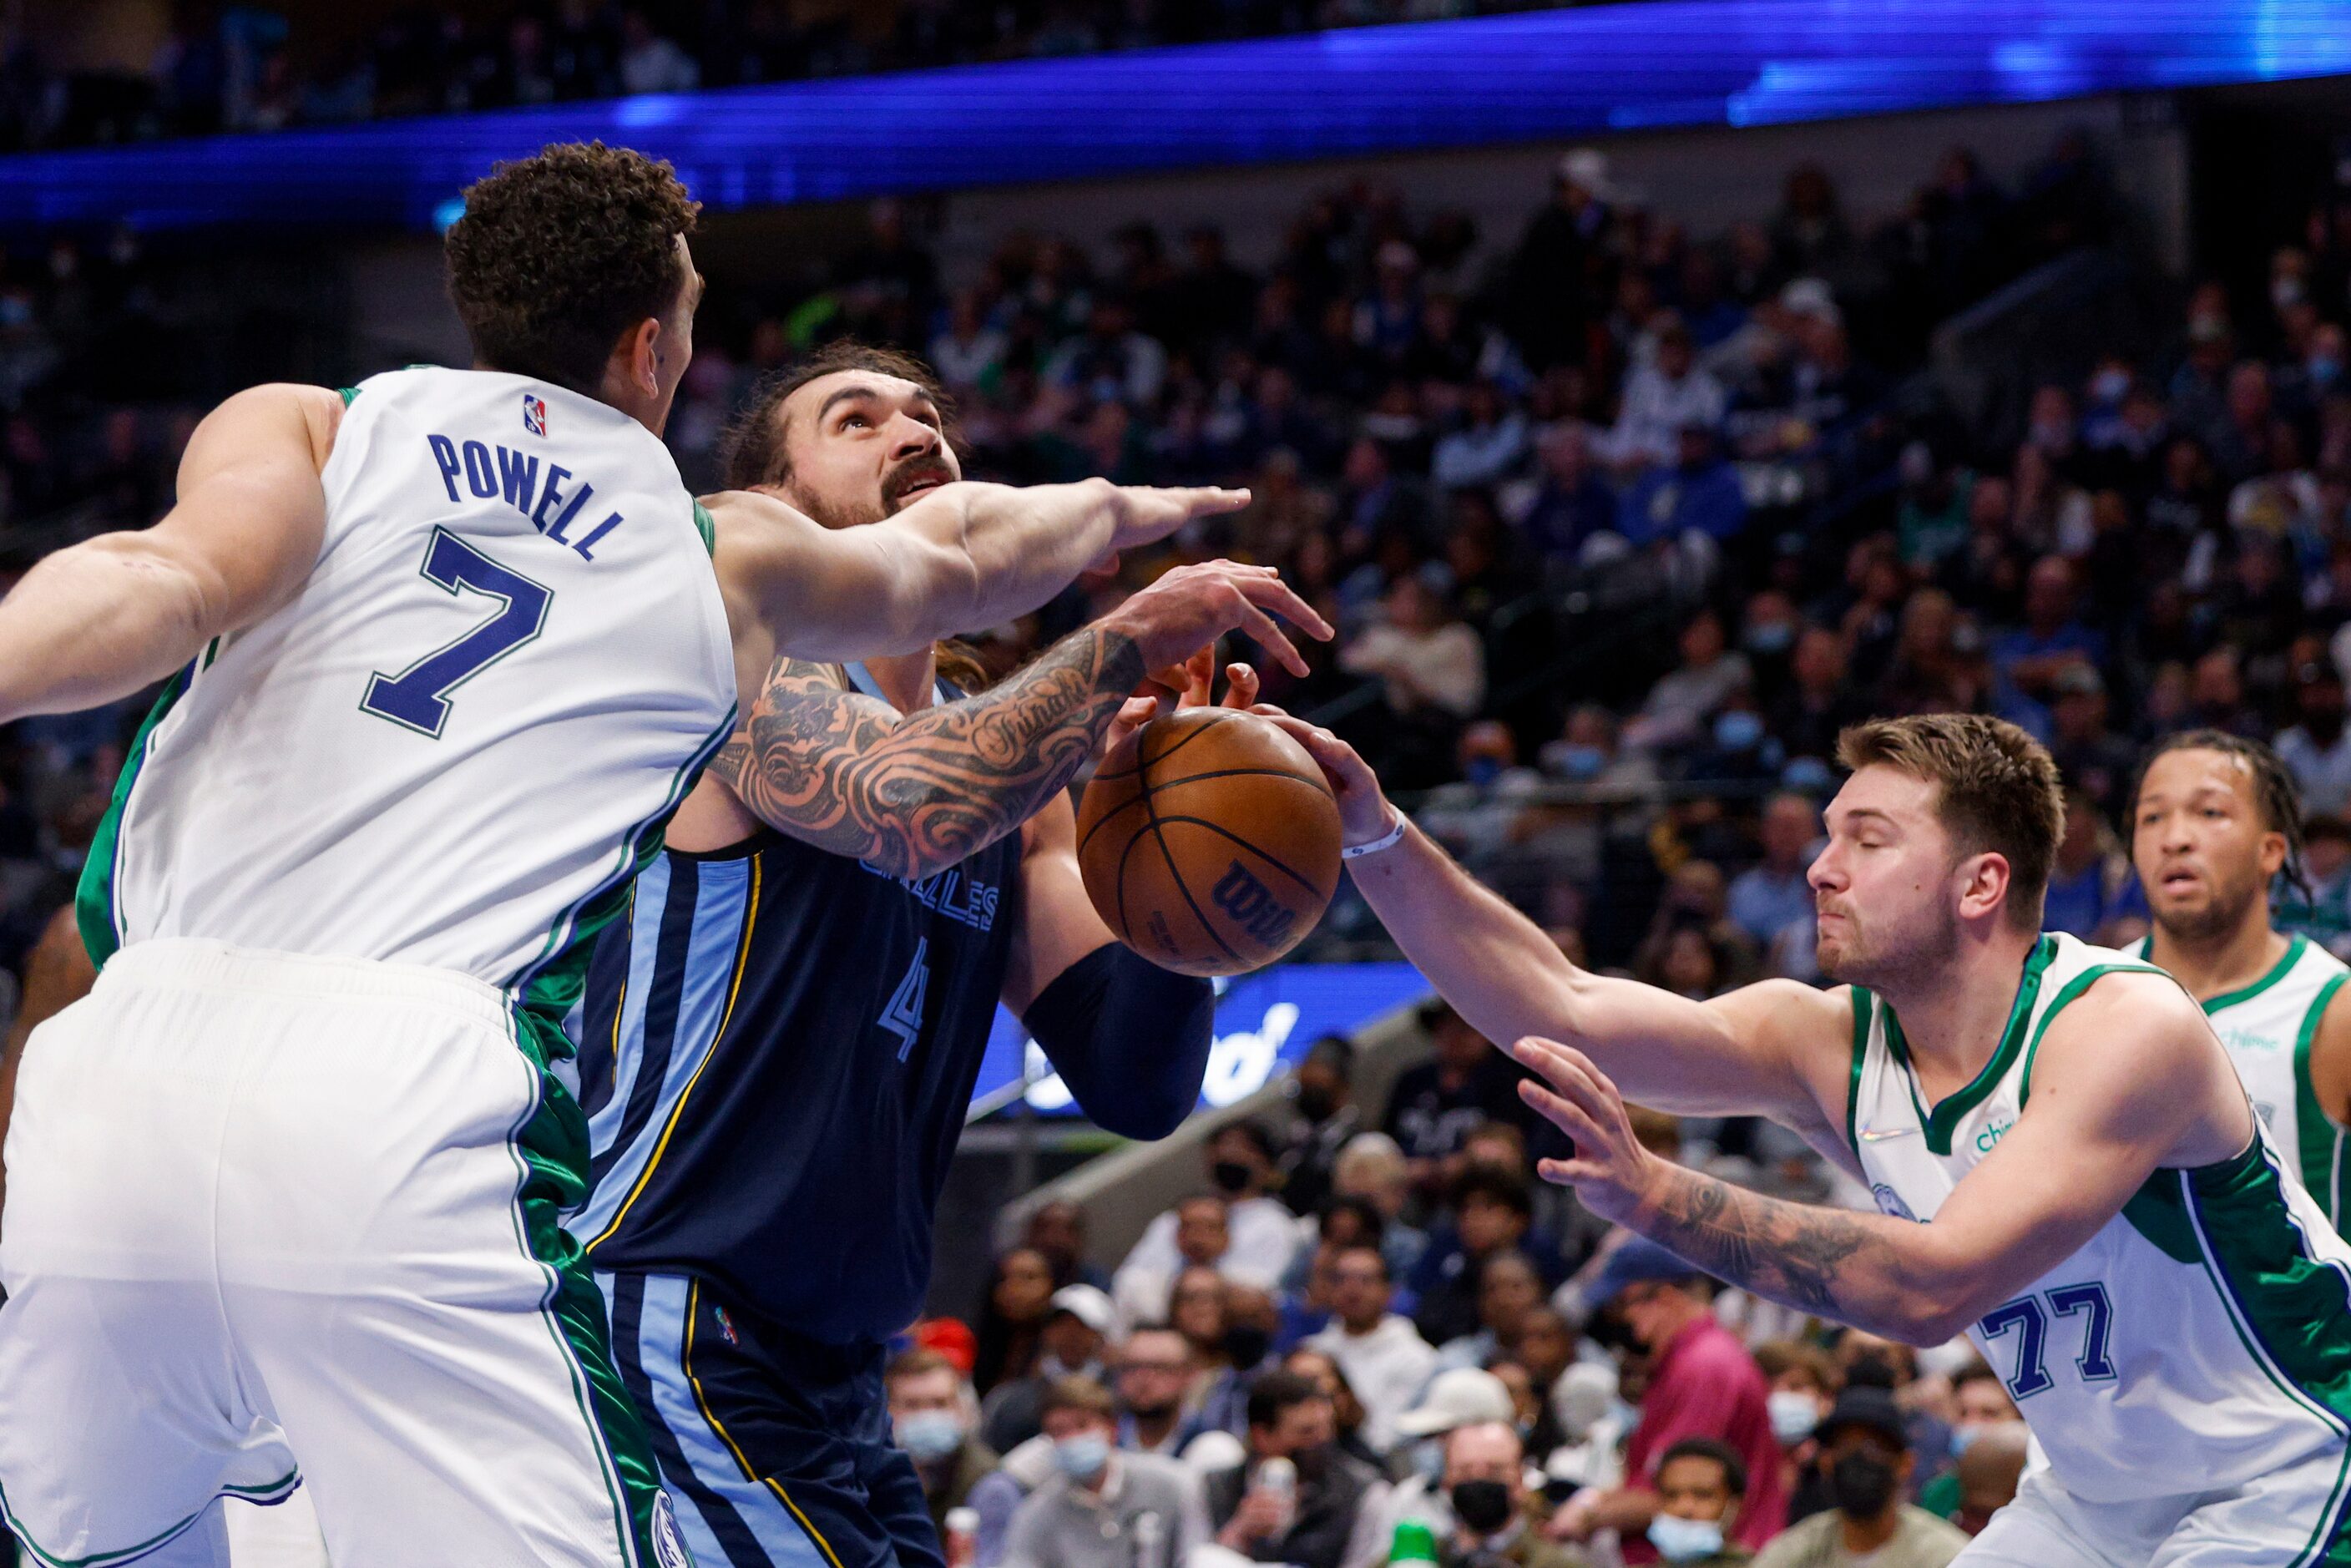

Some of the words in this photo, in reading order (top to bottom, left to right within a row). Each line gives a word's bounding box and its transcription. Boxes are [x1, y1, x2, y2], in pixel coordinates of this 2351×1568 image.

[427, 434, 624, 562] POWELL
[358, 524, 555, 741] 7
[1211, 857, 1299, 948] Wil
[877, 935, 931, 1064] 4
[1977, 1281, 2117, 1401] 77
